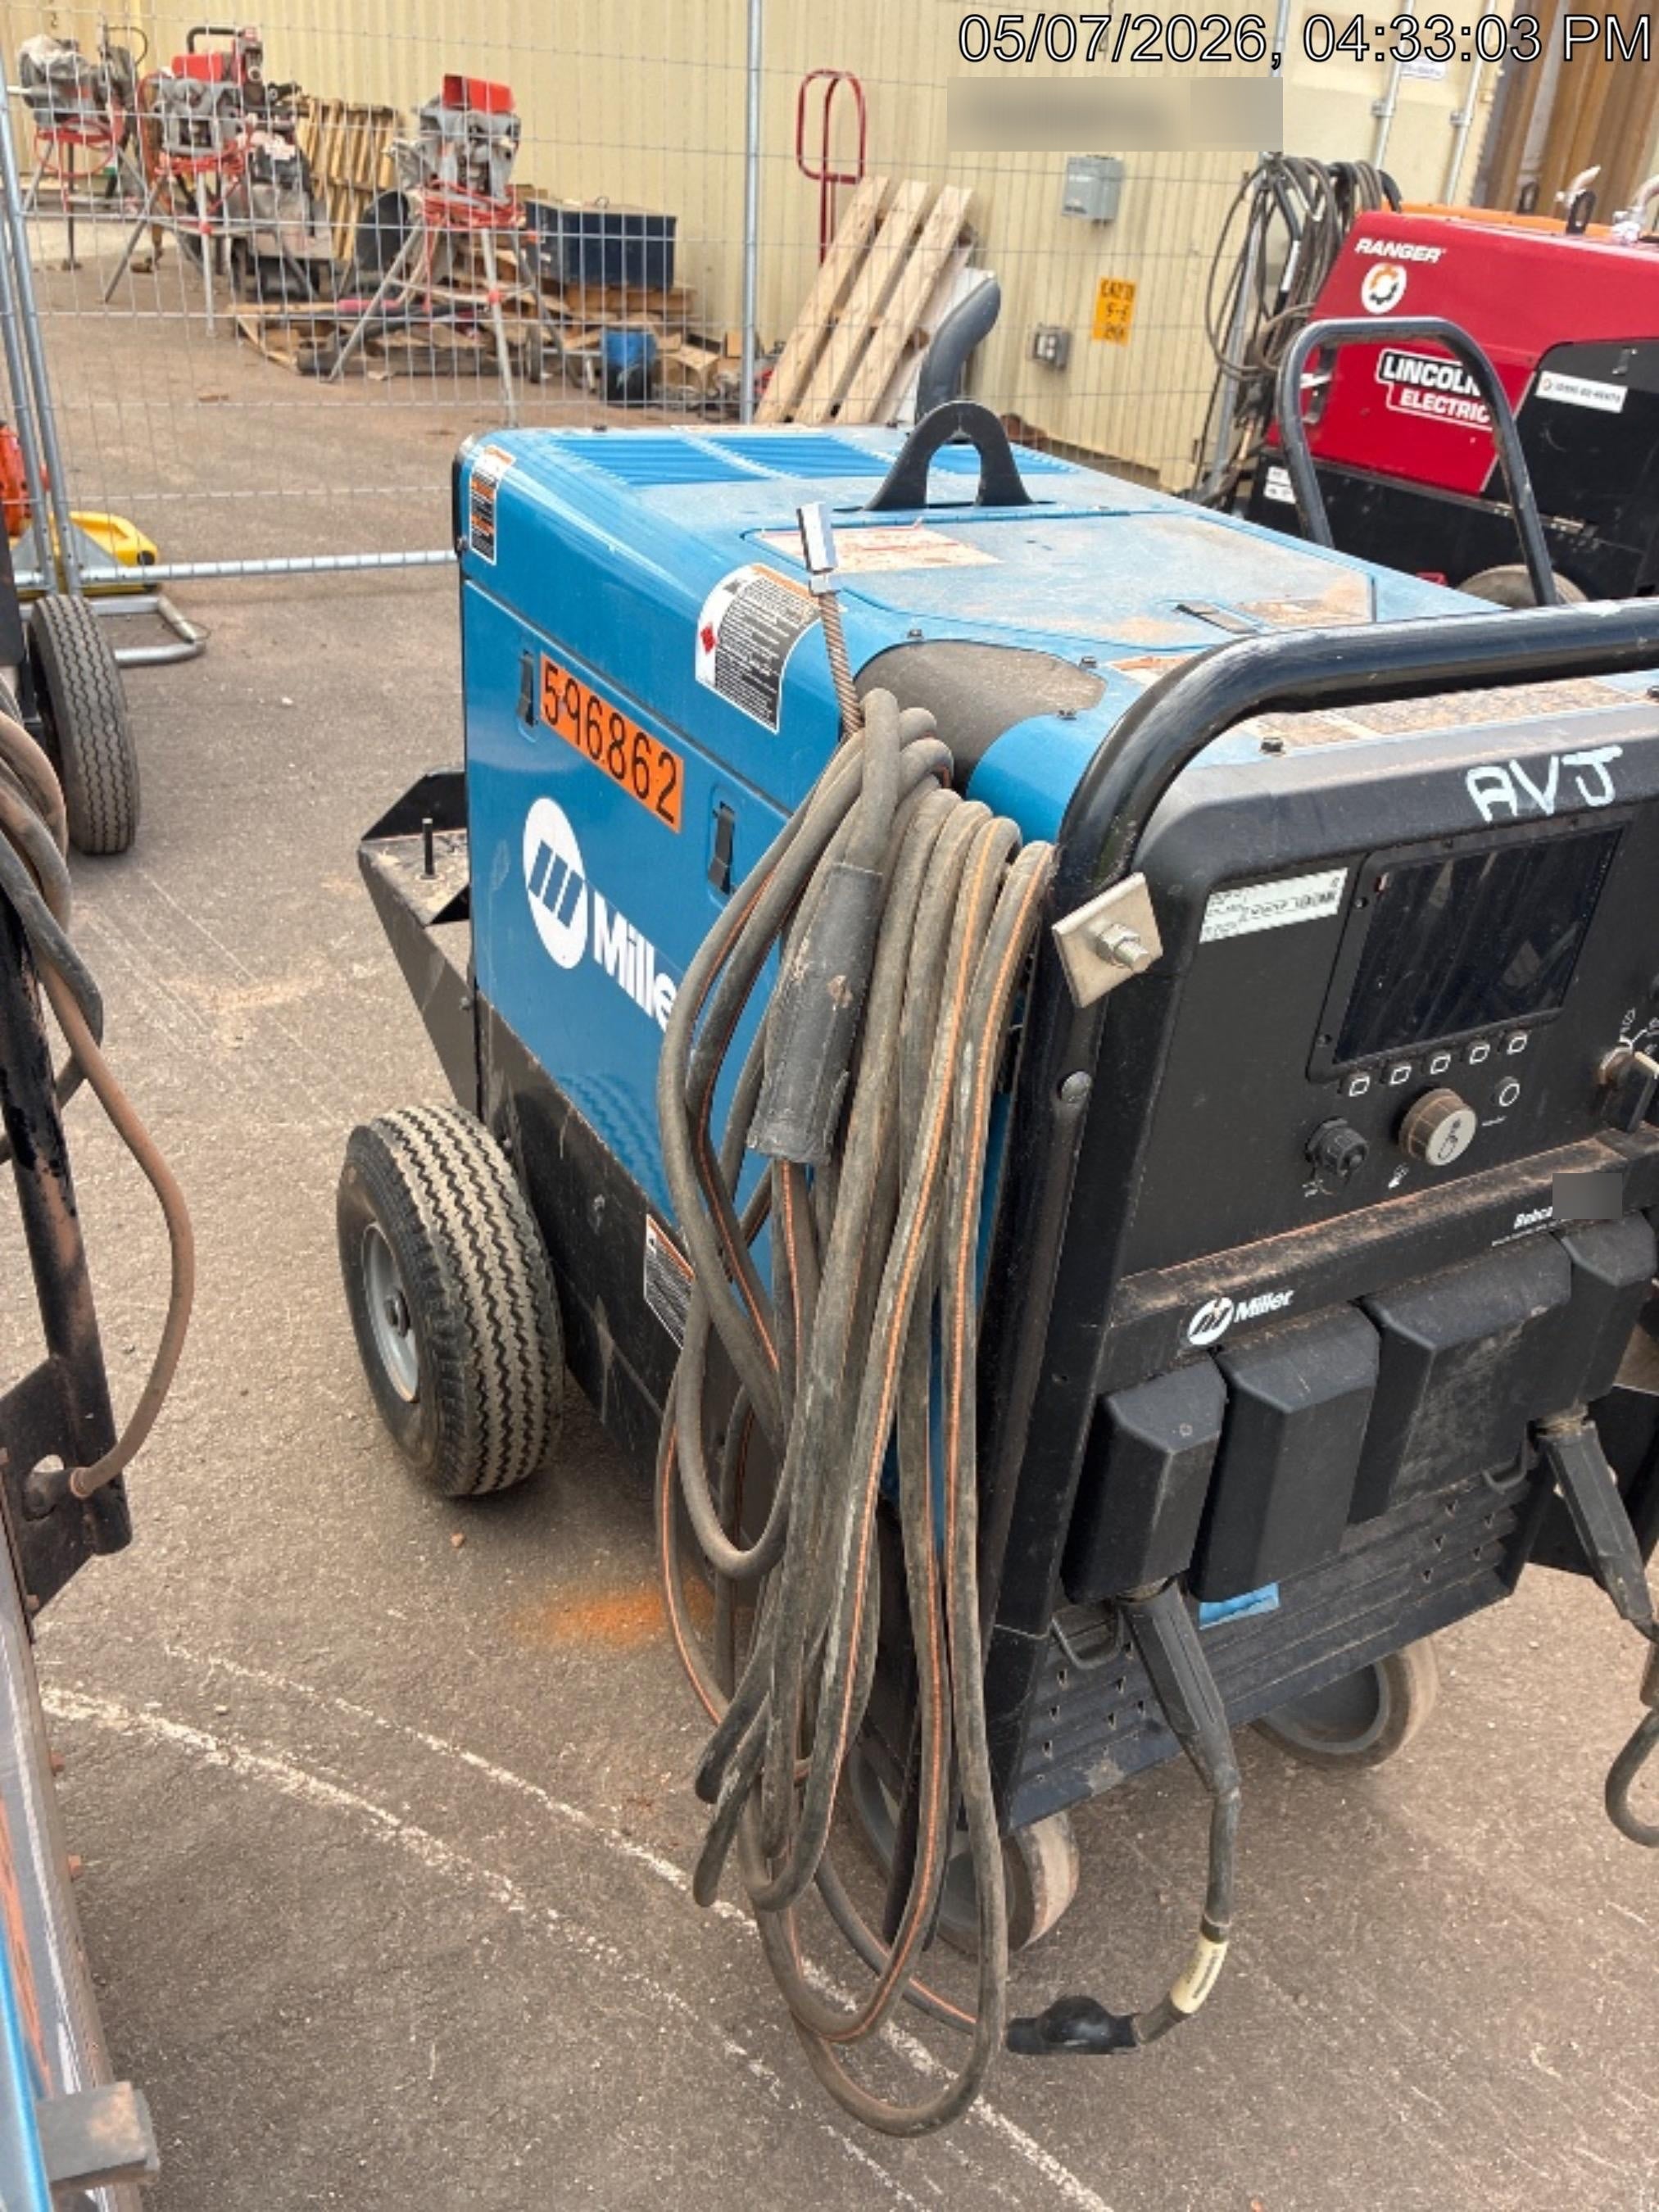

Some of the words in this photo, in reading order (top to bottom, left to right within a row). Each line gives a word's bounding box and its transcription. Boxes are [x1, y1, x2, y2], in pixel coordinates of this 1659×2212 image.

[1354, 238, 1442, 263] RANGER
[1400, 388, 1490, 424] ELECTRIC
[544, 660, 675, 824] 596862
[1465, 744, 1623, 823] AVJ
[593, 889, 678, 1033] Mille
[1233, 1290, 1295, 1323] Miller
